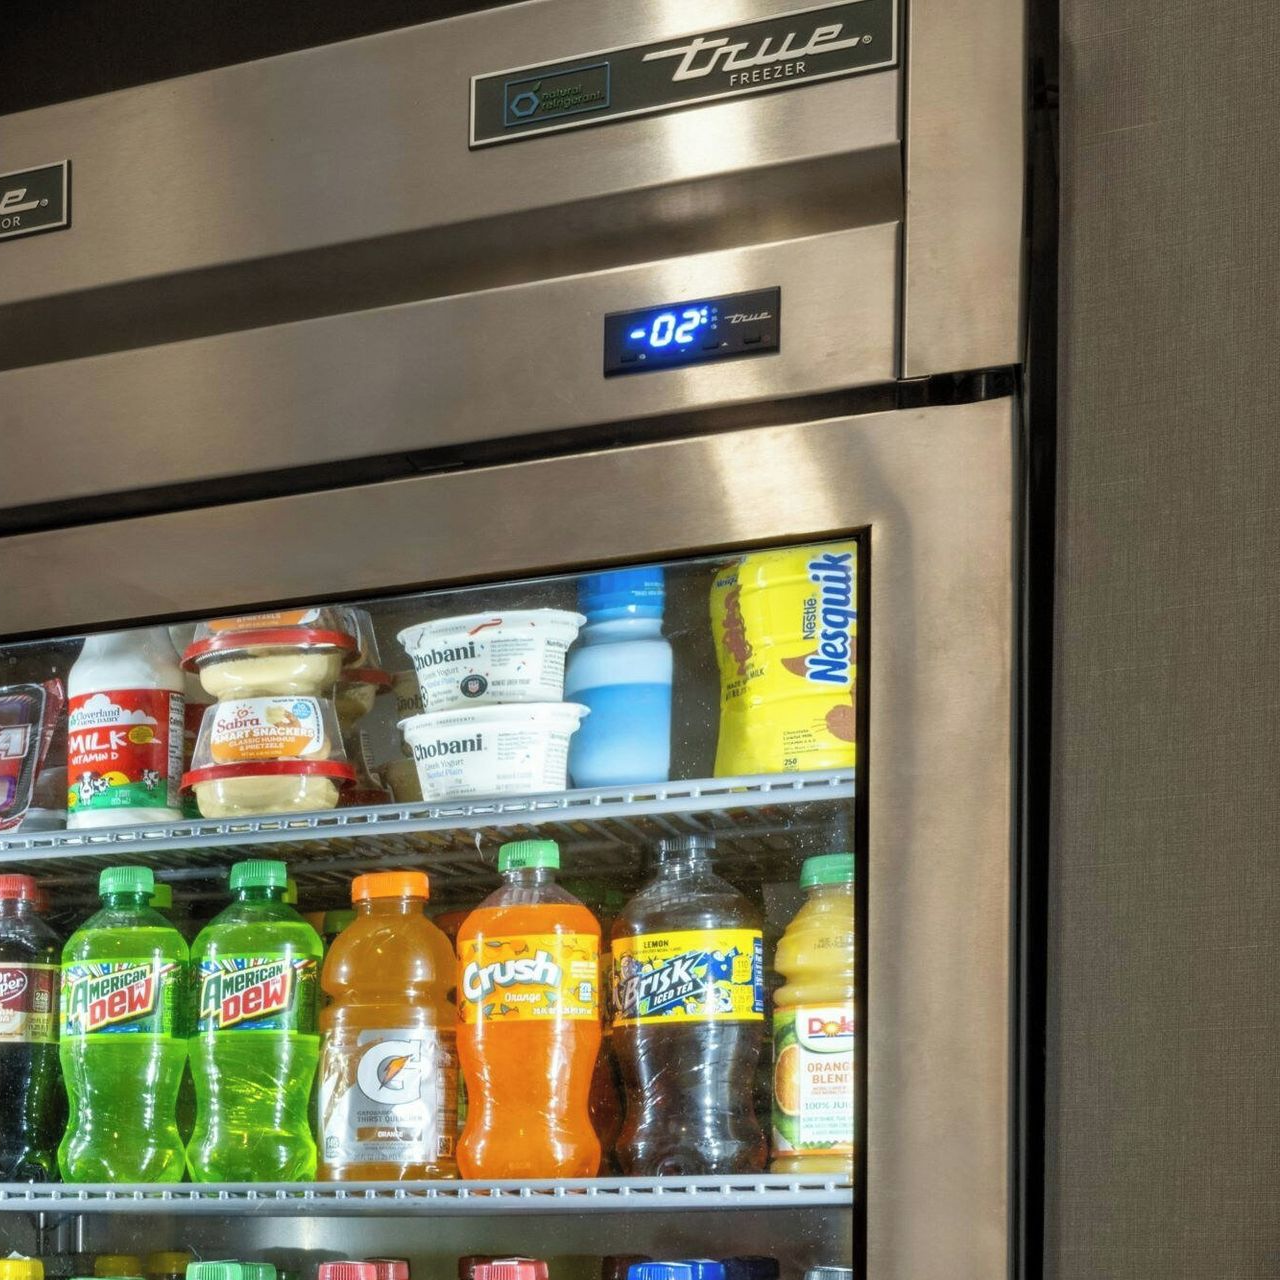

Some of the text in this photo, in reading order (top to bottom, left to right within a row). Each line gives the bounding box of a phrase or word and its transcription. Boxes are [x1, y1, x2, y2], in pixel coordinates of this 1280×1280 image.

[642, 23, 859, 82] true
[729, 62, 807, 87] FREEZER
[542, 84, 583, 102] natural
[807, 552, 856, 685] Nesquik
[216, 716, 260, 735] Sabra
[252, 726, 315, 738] SNACKERS
[69, 729, 128, 755] MILK
[414, 733, 483, 762] Chobani
[70, 751, 120, 765] VITAMIN D
[643, 939, 669, 950] LEMON
[462, 950, 562, 1003] Crush
[504, 992, 541, 1004] Orange
[653, 982, 694, 1007] ICED TEA
